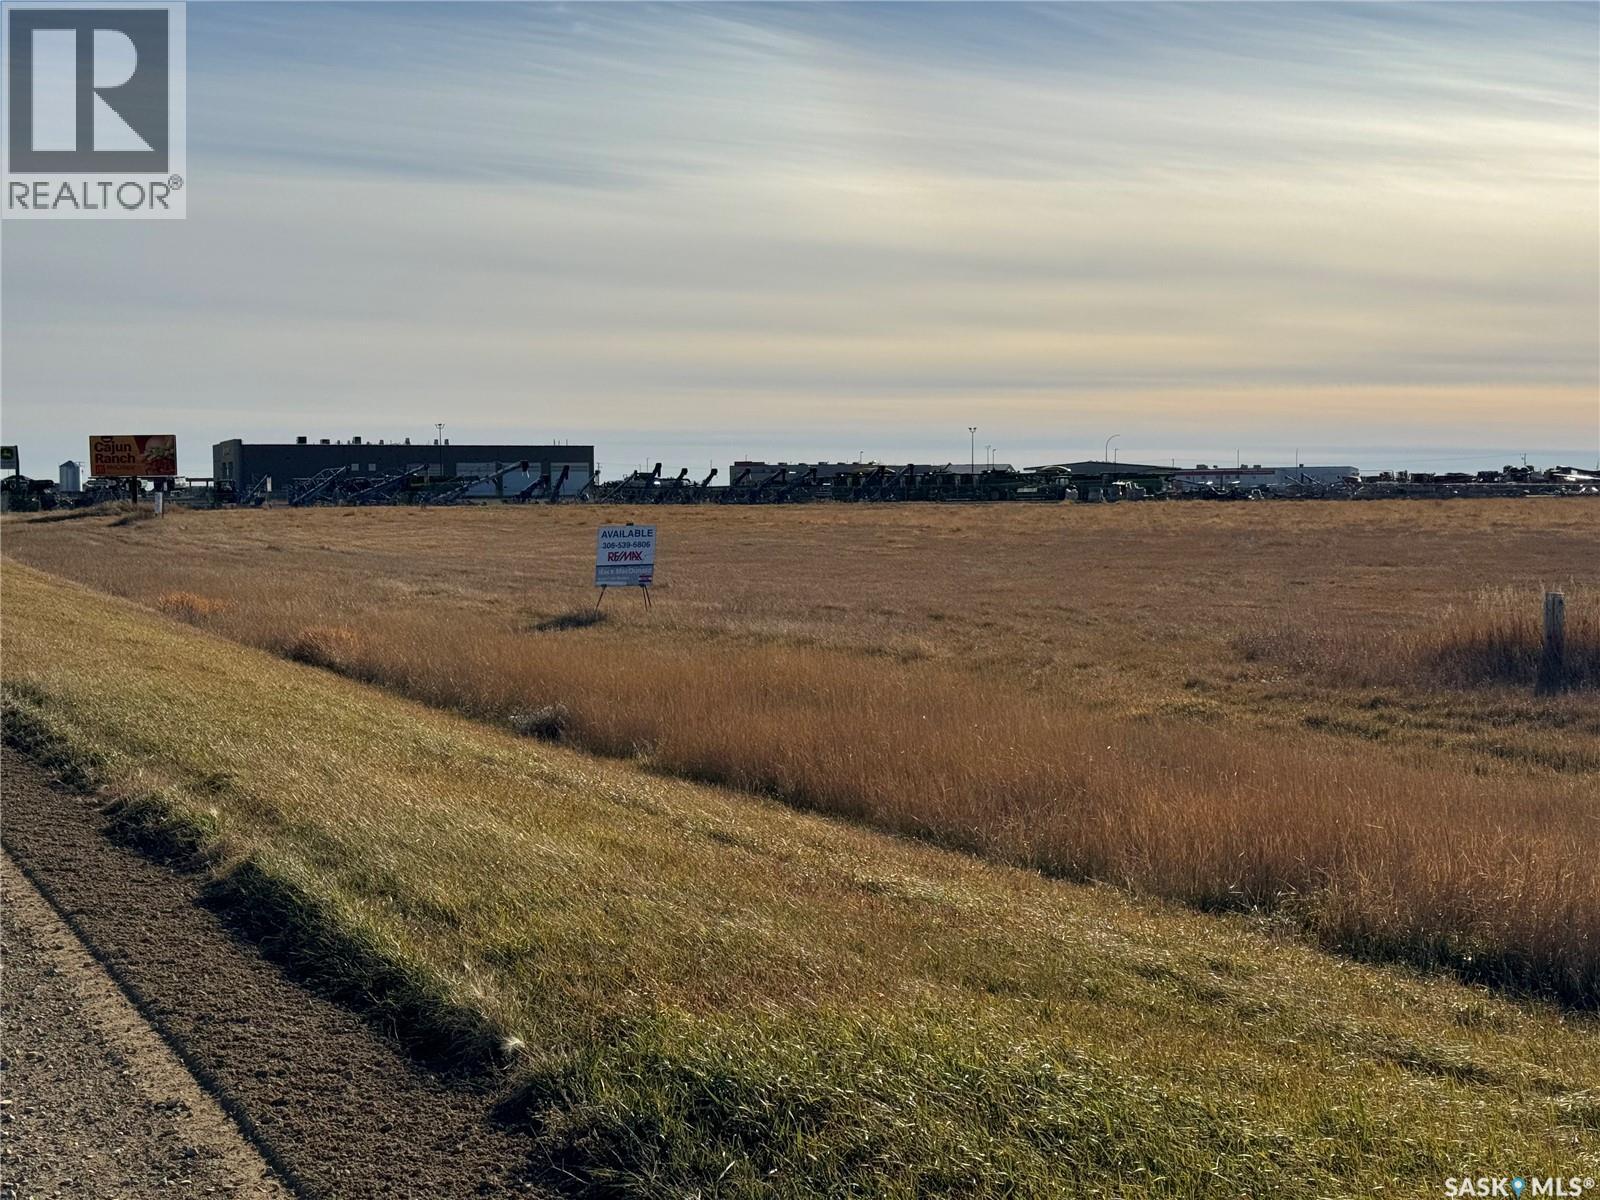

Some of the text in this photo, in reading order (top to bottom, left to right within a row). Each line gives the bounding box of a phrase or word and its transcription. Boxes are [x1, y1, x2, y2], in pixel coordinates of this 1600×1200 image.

[95, 441, 131, 454] Cajun
[95, 453, 135, 463] Ranch
[601, 529, 653, 538] AVAILABLE
[607, 551, 643, 561] RE/MAX
